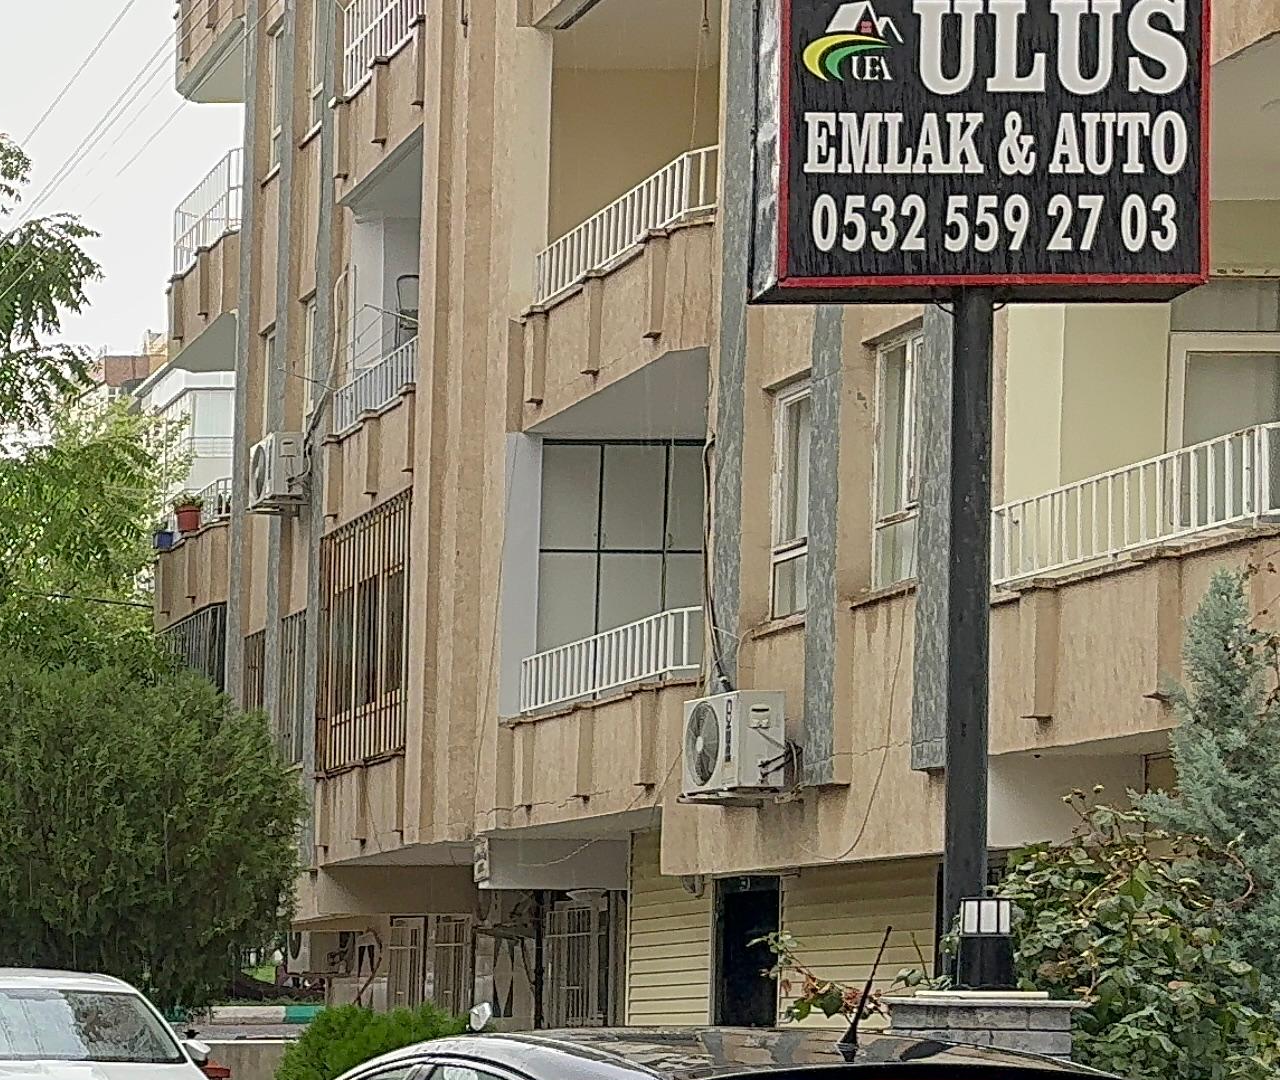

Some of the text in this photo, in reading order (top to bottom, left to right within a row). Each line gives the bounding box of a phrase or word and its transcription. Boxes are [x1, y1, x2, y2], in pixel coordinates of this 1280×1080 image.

[912, 0, 1187, 95] ULUS
[803, 110, 1187, 176] EMLAK & AUTO
[812, 193, 1178, 254] 0532 559 27 03
